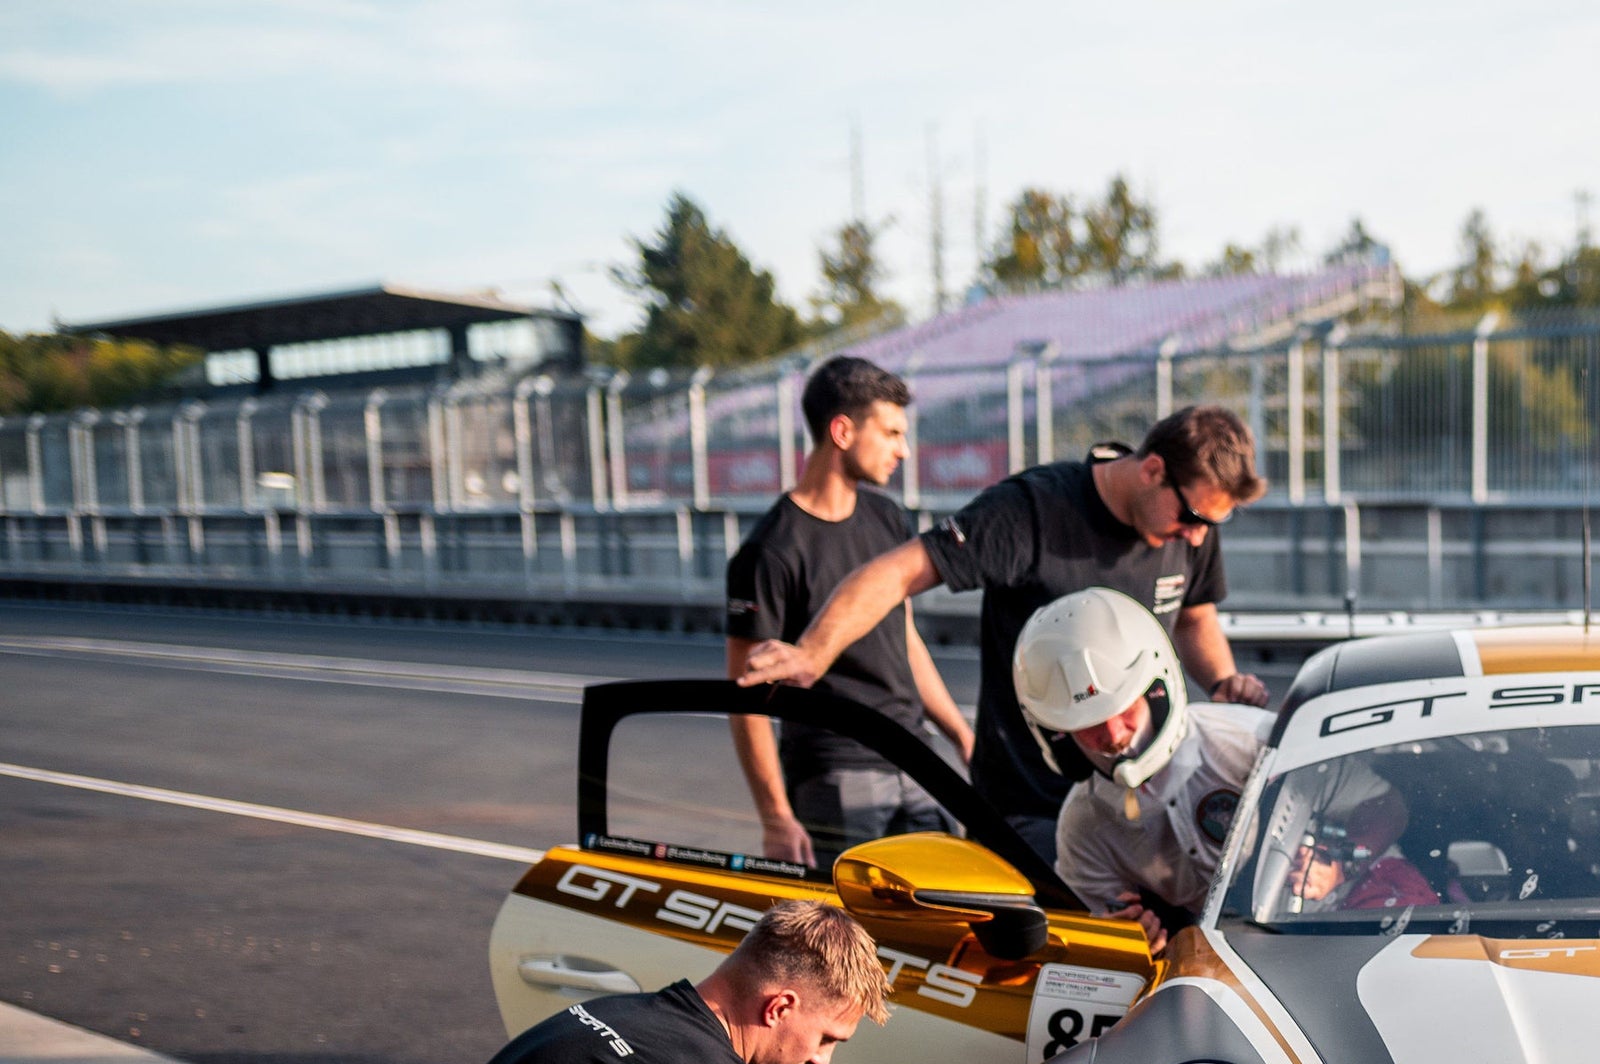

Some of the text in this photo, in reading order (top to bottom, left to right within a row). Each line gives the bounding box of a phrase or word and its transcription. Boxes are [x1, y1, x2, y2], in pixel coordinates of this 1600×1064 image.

[1319, 692, 1467, 737] GT
[556, 863, 984, 1008] GT SPTS
[1500, 946, 1597, 959] GT
